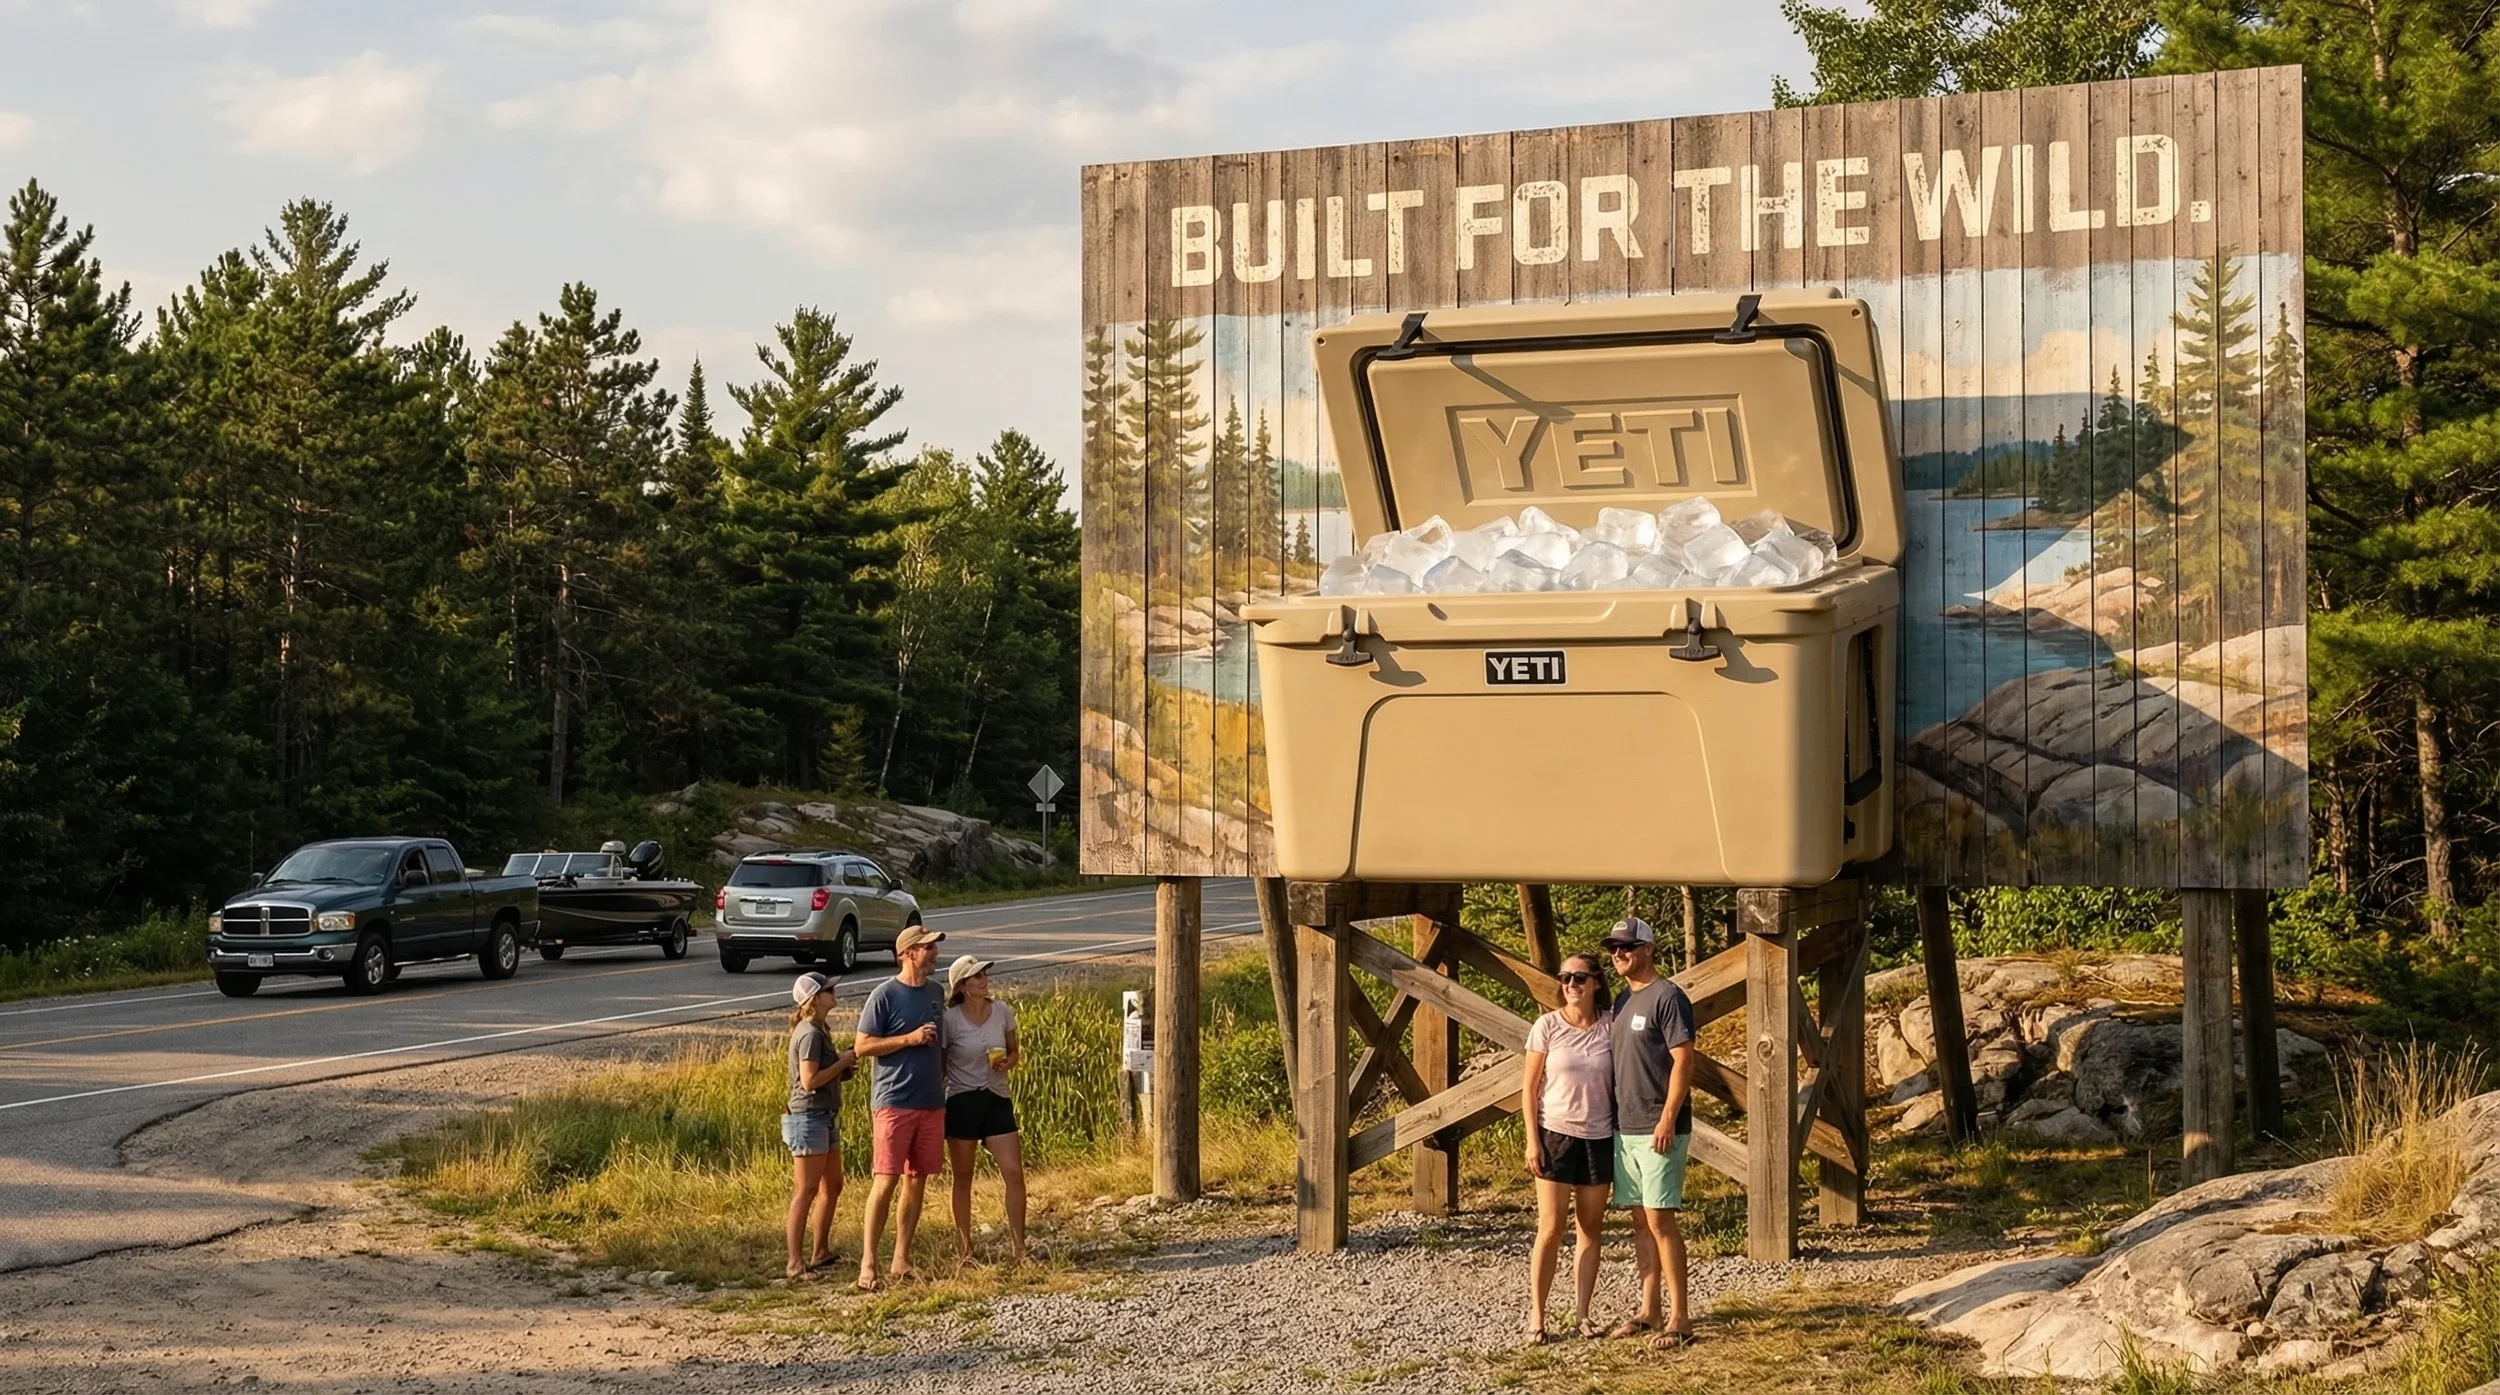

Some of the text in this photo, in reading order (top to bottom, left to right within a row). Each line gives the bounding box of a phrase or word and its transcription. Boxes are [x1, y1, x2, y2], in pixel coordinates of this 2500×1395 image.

[1171, 134, 2211, 288] BUILT FOR THE WILD.
[1460, 407, 1743, 490] YETI
[1488, 657, 1559, 680] YETI
